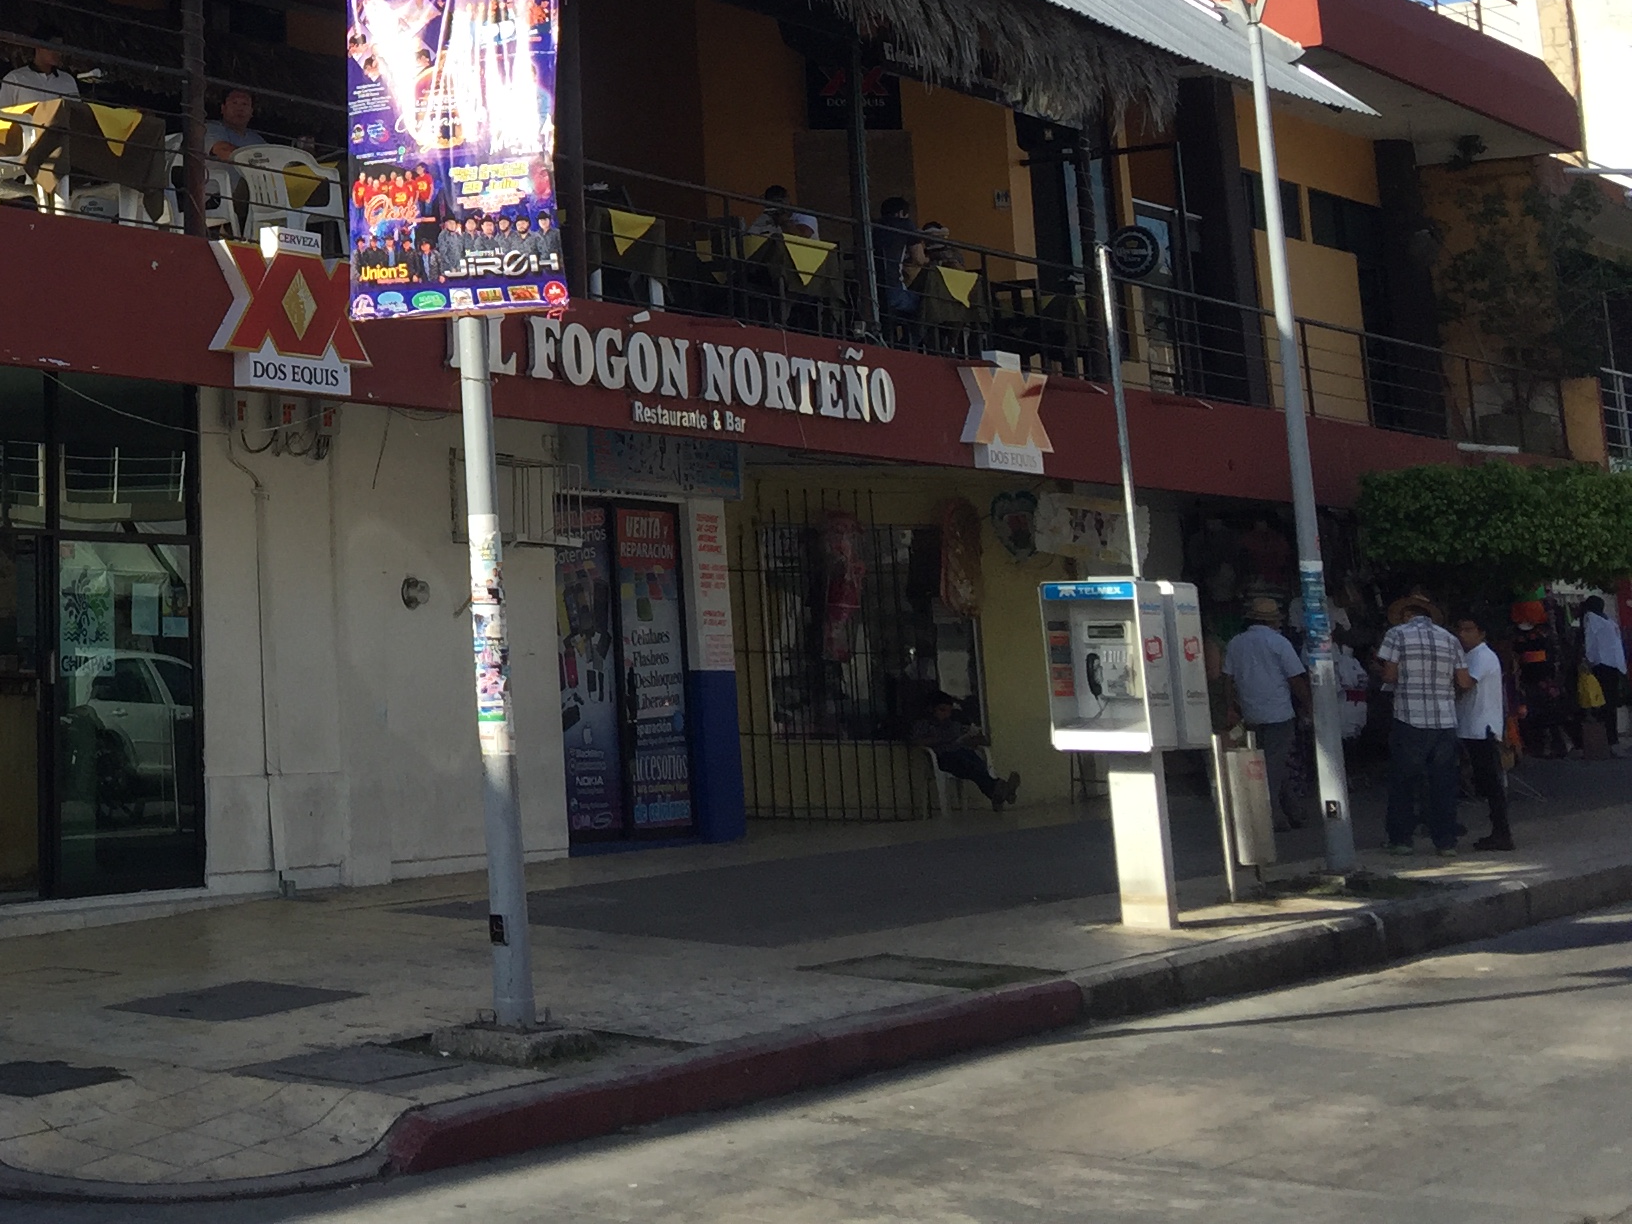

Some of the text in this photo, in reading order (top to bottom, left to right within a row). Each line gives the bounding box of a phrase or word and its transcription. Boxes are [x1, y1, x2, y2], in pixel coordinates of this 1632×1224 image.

[277, 232, 320, 249] CERVEZA
[252, 360, 339, 387] DOS EQUIS
[449, 311, 896, 424] L FOGÓN NORTEÑO
[633, 400, 746, 433] Restaurante & Bar
[990, 449, 1037, 468] DOS EQUIS
[625, 515, 661, 539] VENTA
[620, 540, 674, 560] REPARACIÓN
[1077, 586, 1123, 596] TELMEX
[631, 628, 671, 647] Celulares
[632, 649, 670, 668] Flasheos
[575, 775, 605, 786] NOKIA
